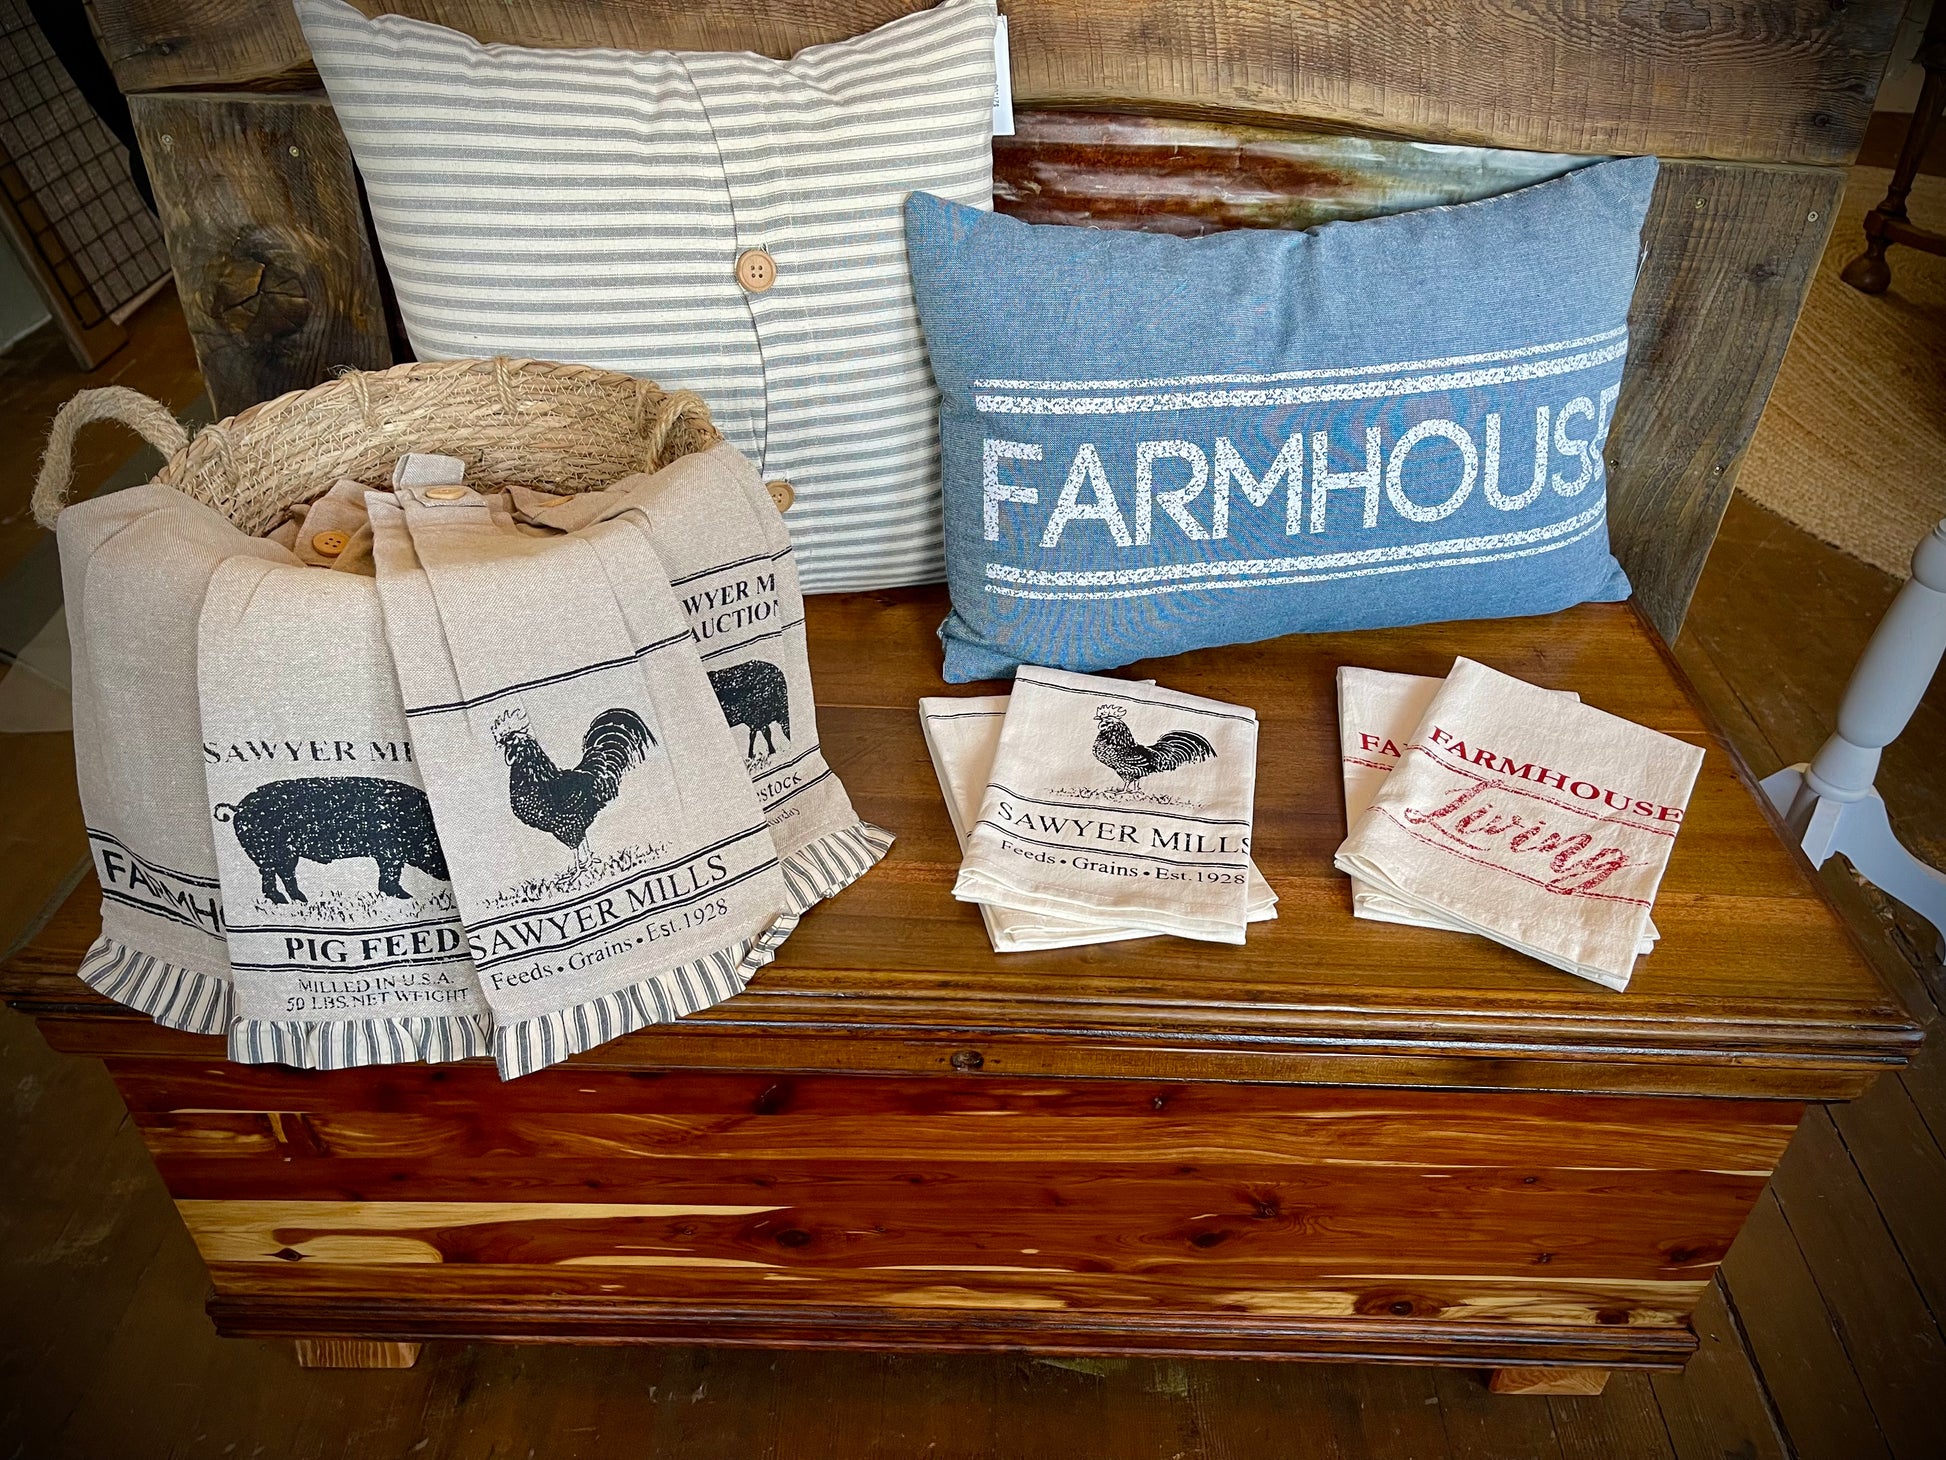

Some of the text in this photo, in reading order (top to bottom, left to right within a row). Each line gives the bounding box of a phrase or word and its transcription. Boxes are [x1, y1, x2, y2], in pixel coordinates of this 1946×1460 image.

[681, 580, 750, 616] WYER
[203, 741, 413, 764] SAWYER MI
[1428, 725, 1684, 824] FARMHOUSE
[997, 801, 1140, 844] SAWYER
[1404, 778, 1649, 896] Living
[468, 854, 728, 961] SAWYER MILLS
[285, 928, 461, 963] PIG FEED
[299, 972, 455, 994] MILLED IN U.S.A.
[352, 992, 391, 1008] NET
